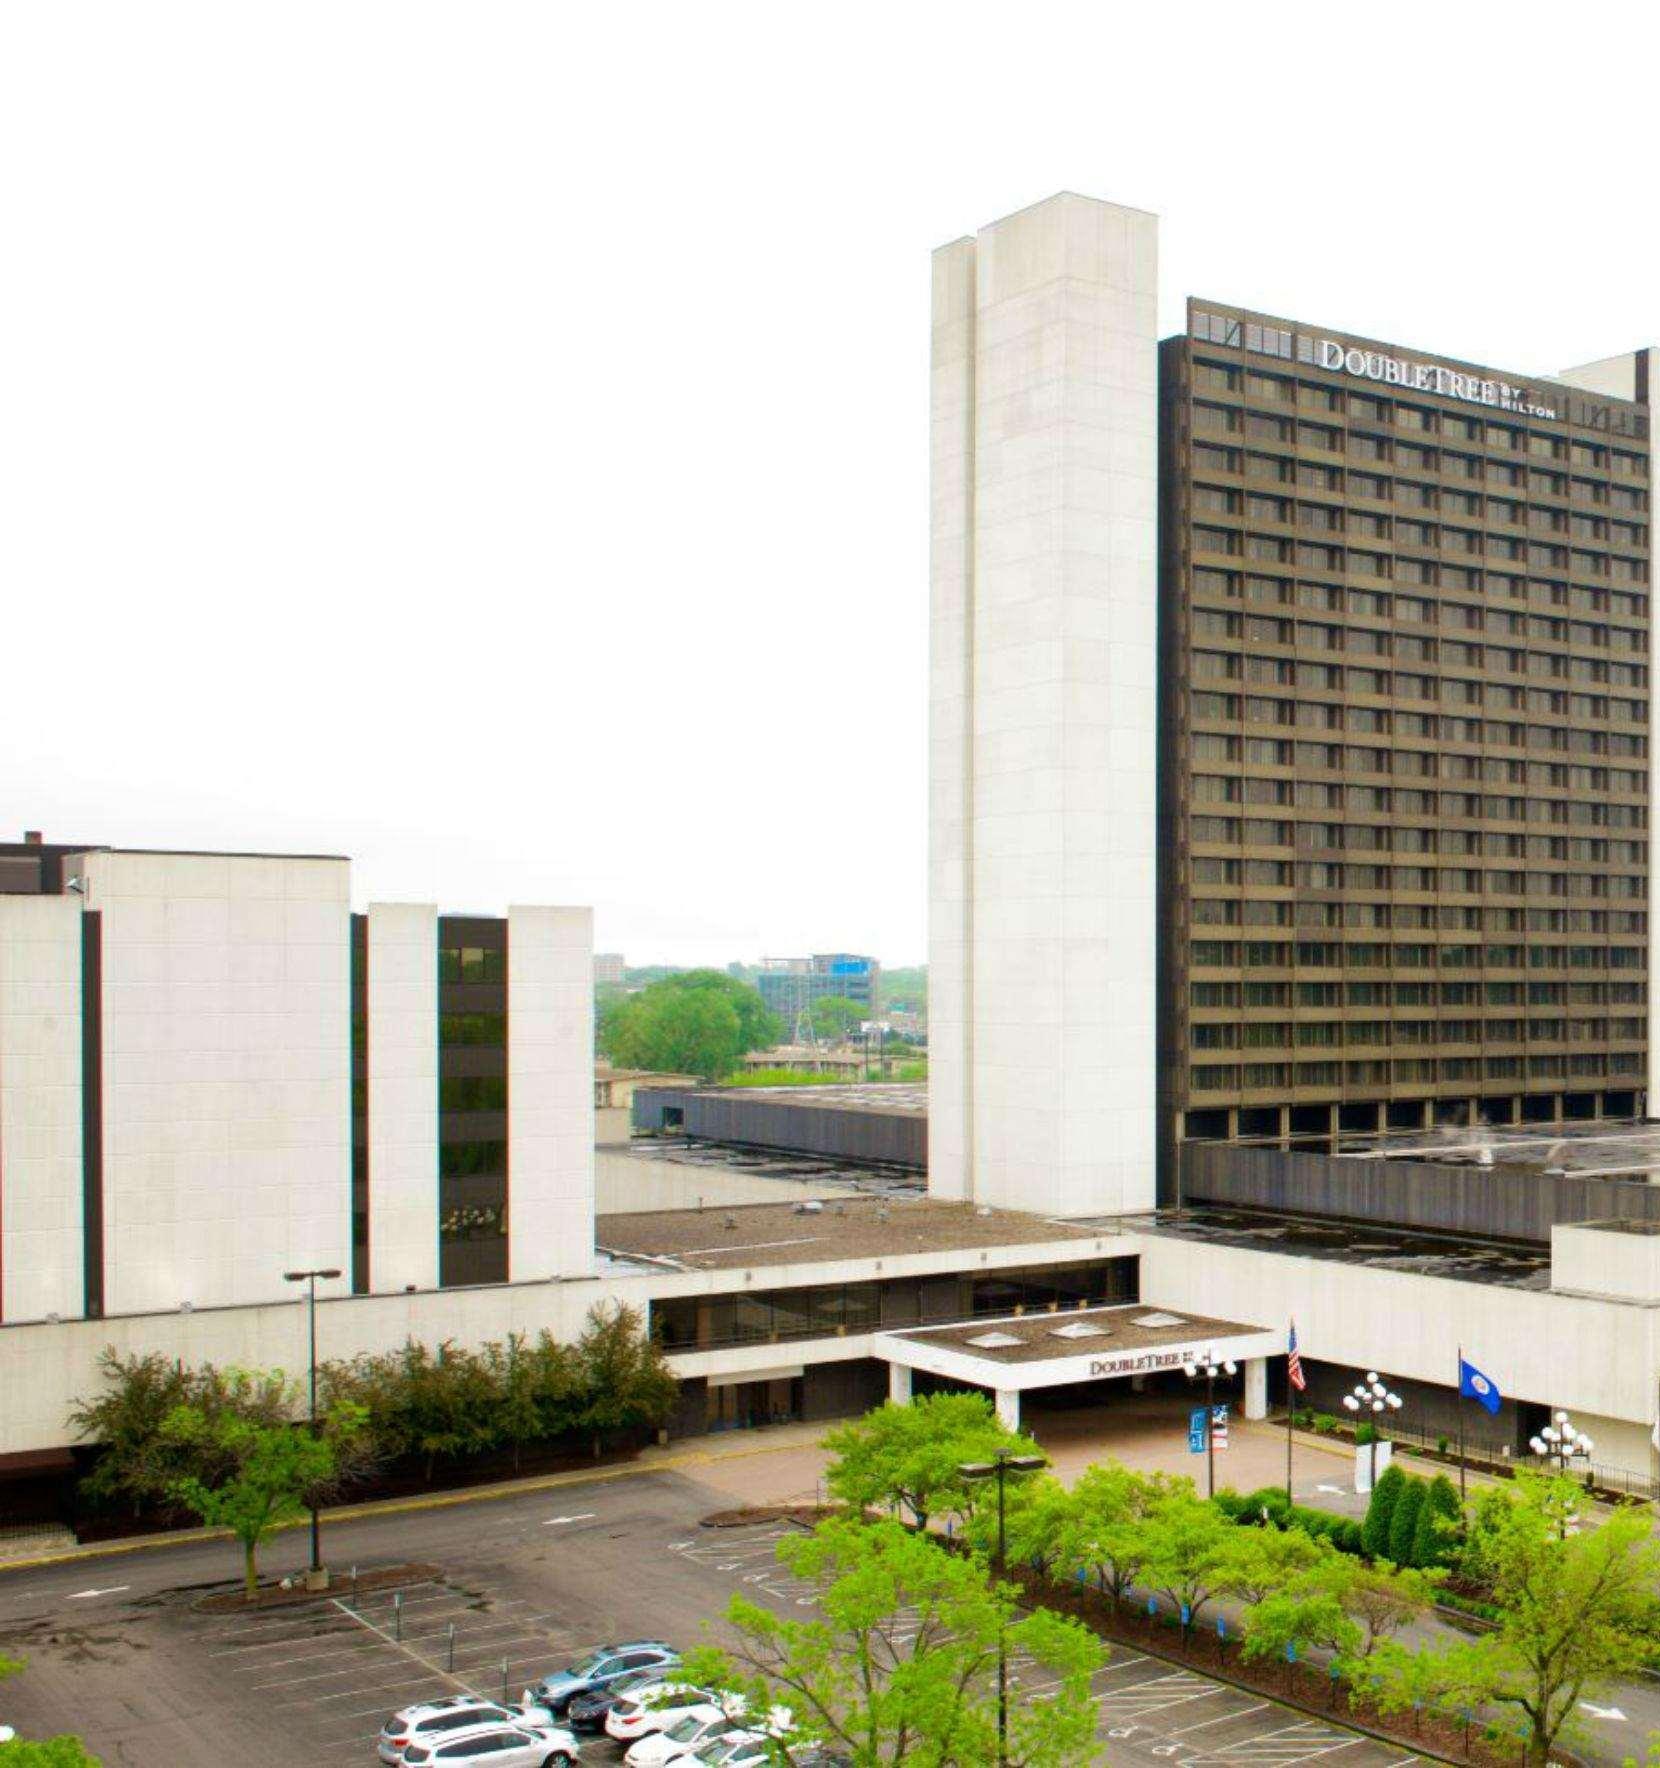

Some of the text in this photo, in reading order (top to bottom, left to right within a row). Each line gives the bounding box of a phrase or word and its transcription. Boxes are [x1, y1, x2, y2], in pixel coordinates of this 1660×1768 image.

[1321, 340, 1497, 405] DOUBLETREE
[1500, 400, 1556, 419] HILTON
[1090, 1352, 1179, 1376] DOUBLETREE
